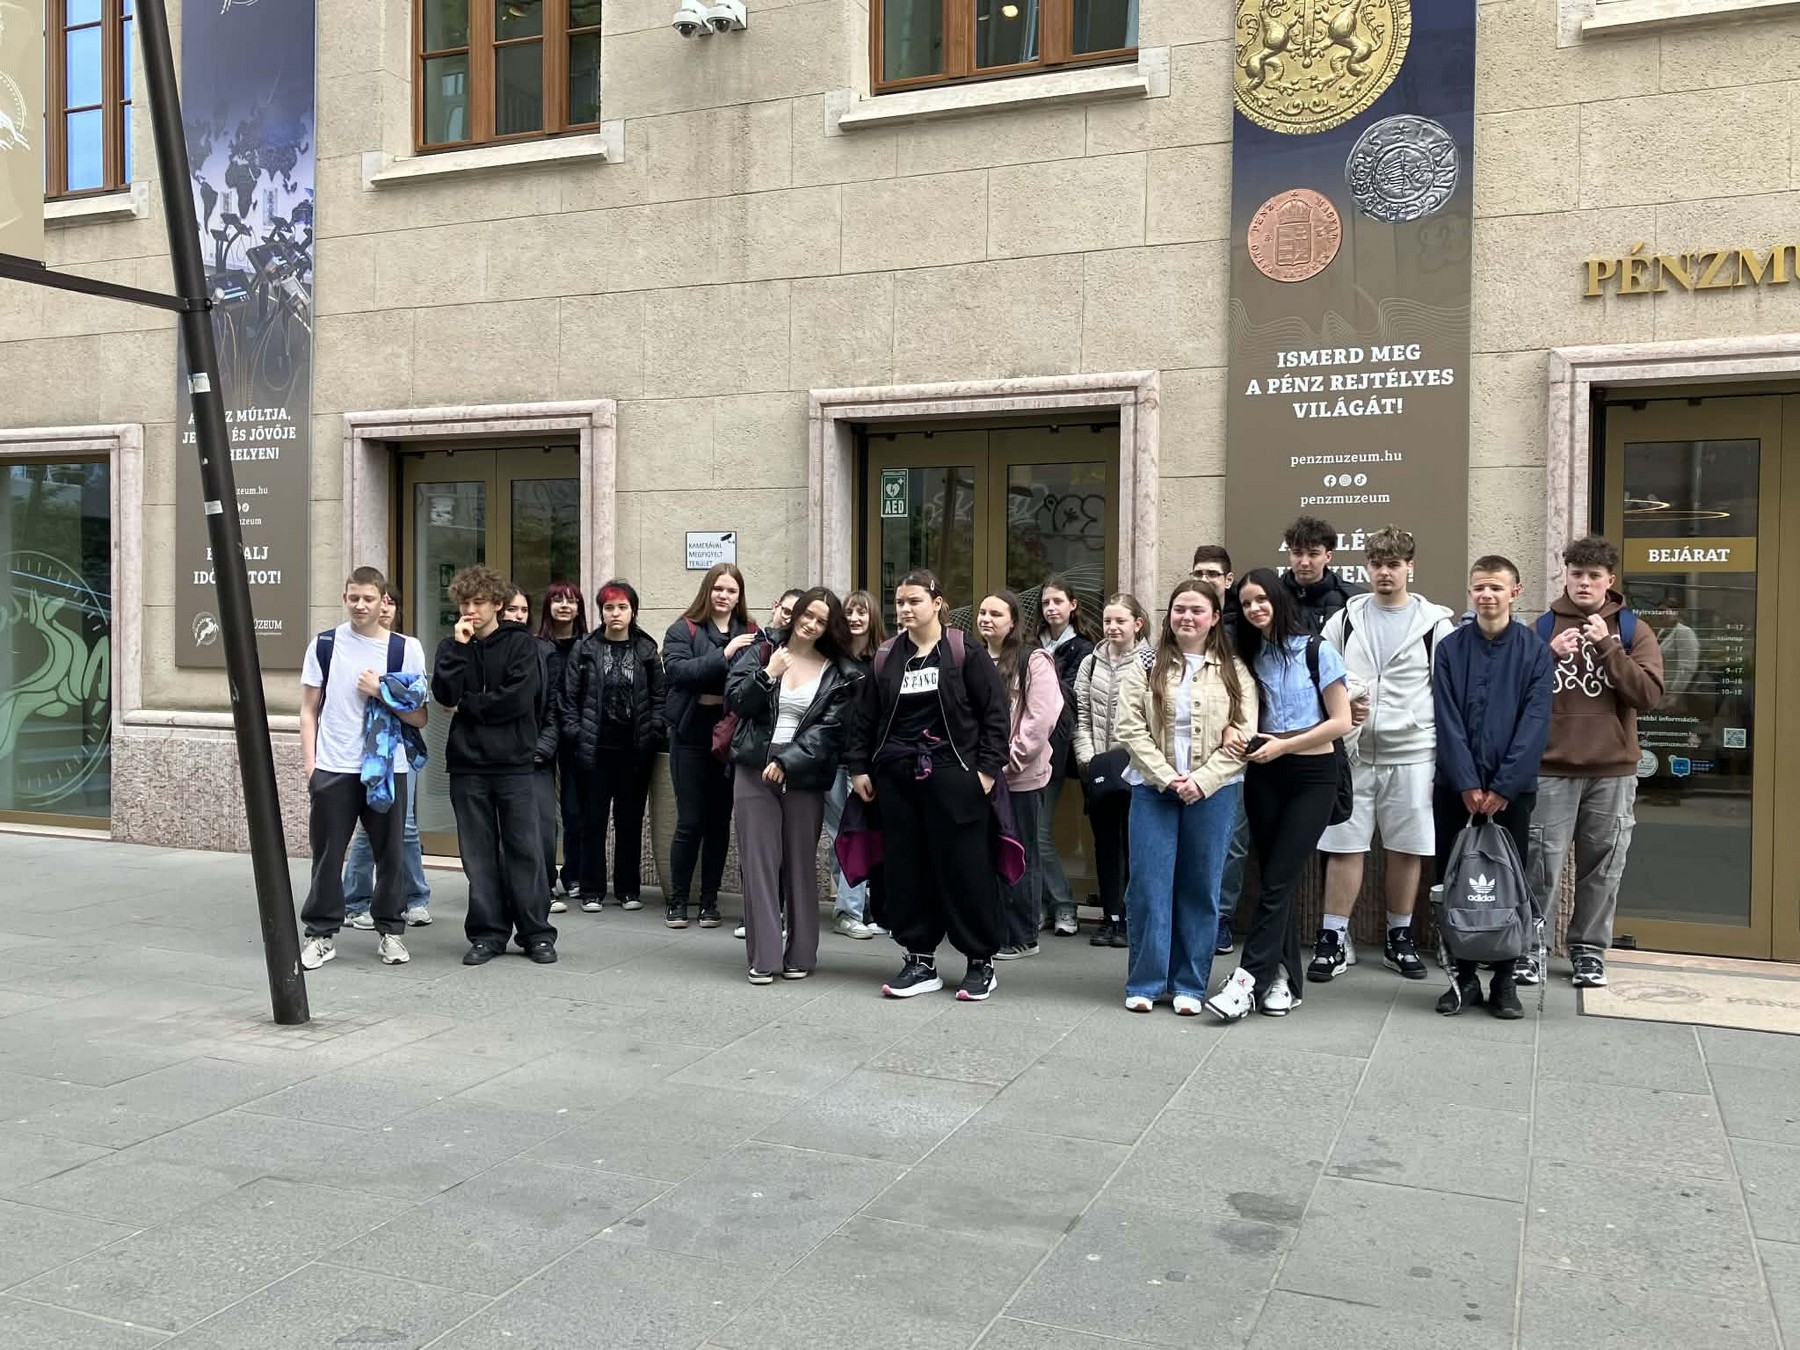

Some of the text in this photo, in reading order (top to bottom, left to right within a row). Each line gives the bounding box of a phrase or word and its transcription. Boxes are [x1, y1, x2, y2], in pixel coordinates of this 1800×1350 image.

[1277, 344, 1422, 368] ISMERD MEG
[1245, 367, 1455, 396] A PÉNZ REJTÉLYES
[236, 406, 291, 422] MÚLTJA,
[1292, 394, 1404, 419] VILÁGÁT!
[231, 423, 296, 442] ÉS JÖVŐJE
[1290, 450, 1403, 468] penzmuzeum.hu
[885, 500, 904, 514] AED
[1300, 494, 1391, 508] penzmuzeum
[1648, 546, 1730, 563] BEJÁRAT
[1467, 894, 1496, 902] adidas
